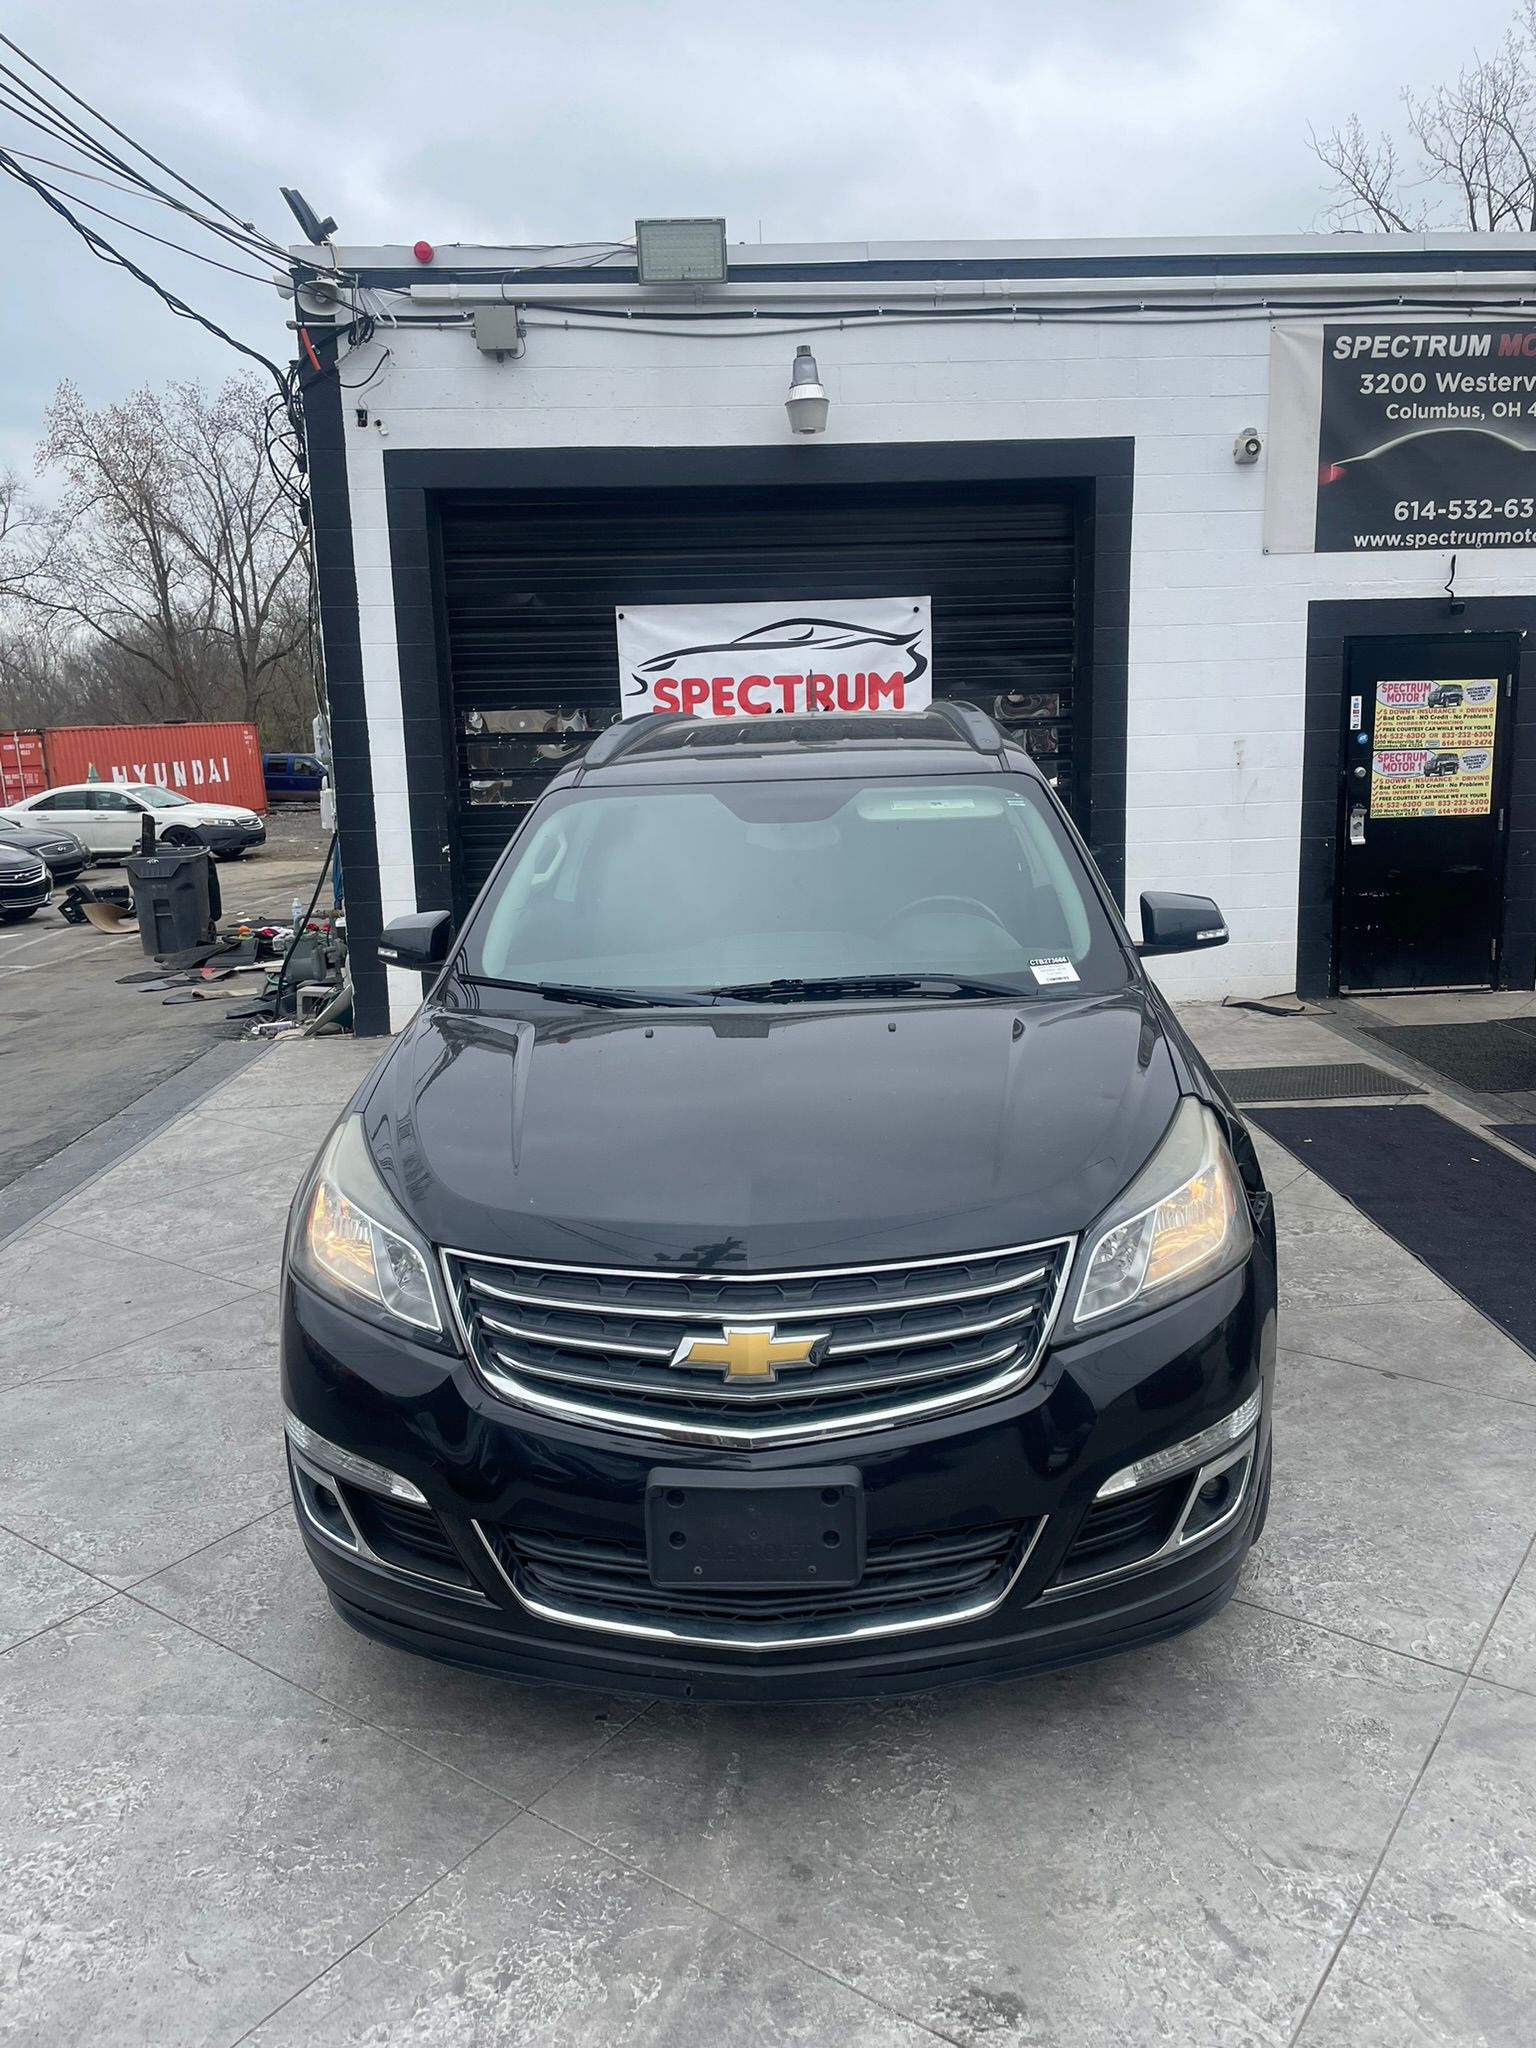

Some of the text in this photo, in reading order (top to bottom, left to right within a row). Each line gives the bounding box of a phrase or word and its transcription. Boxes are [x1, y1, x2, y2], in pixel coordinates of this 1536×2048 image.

[1333, 334, 1491, 359] SPECTRUM
[1359, 373, 1427, 394] 3200
[1386, 402, 1486, 421] Columbus,
[1492, 402, 1521, 417] OH
[653, 671, 904, 716] SPECTRUM
[1382, 683, 1431, 693] SPECTRUM
[1387, 694, 1421, 702] MOTOR
[1377, 752, 1427, 762] SPECTRUM
[112, 757, 230, 788] HYUNDAI
[1382, 763, 1416, 772] MOTOR
